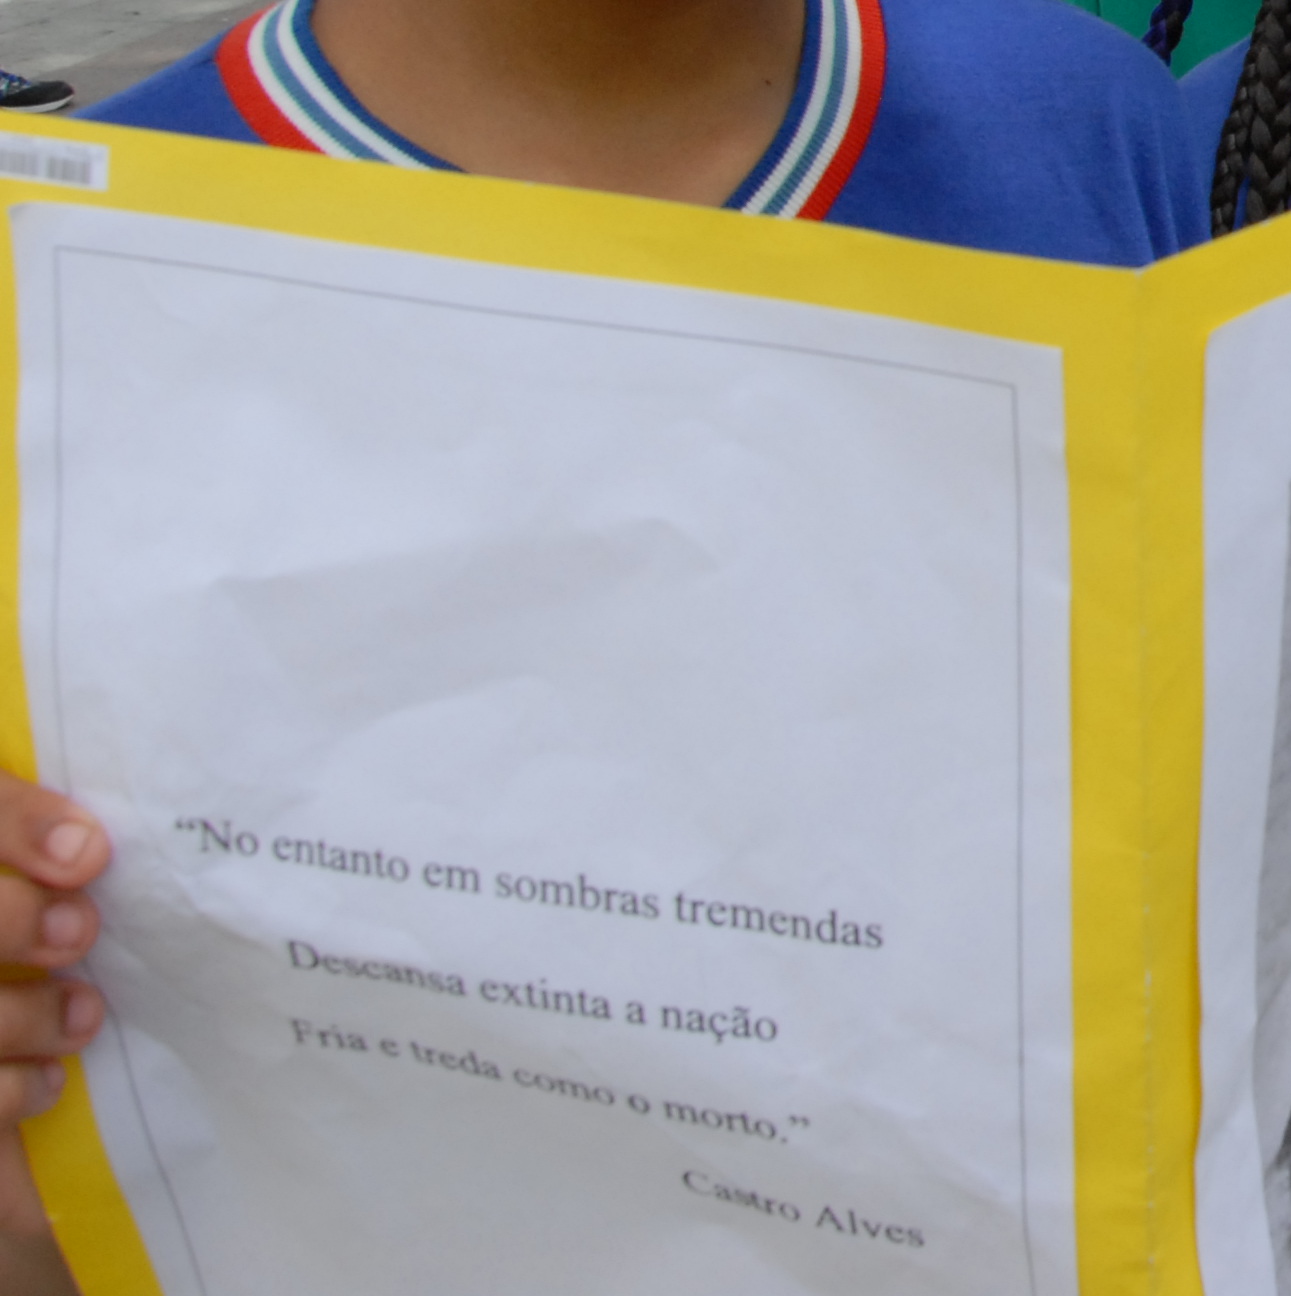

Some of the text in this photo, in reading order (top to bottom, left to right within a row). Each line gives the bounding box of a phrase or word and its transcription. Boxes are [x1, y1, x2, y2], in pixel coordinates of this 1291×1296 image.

[271, 834, 410, 883] entanto
[422, 860, 482, 895] em
[494, 871, 661, 920] sombras
[673, 889, 885, 951] tremendas
[286, 939, 779, 1045] Descansa extinta a nação
[290, 1017, 369, 1053] Fria
[378, 1037, 402, 1058] e
[409, 1039, 503, 1082] treda
[512, 1066, 616, 1107] como
[627, 1093, 652, 1116] o
[681, 1169, 926, 1249] Castro Alves
